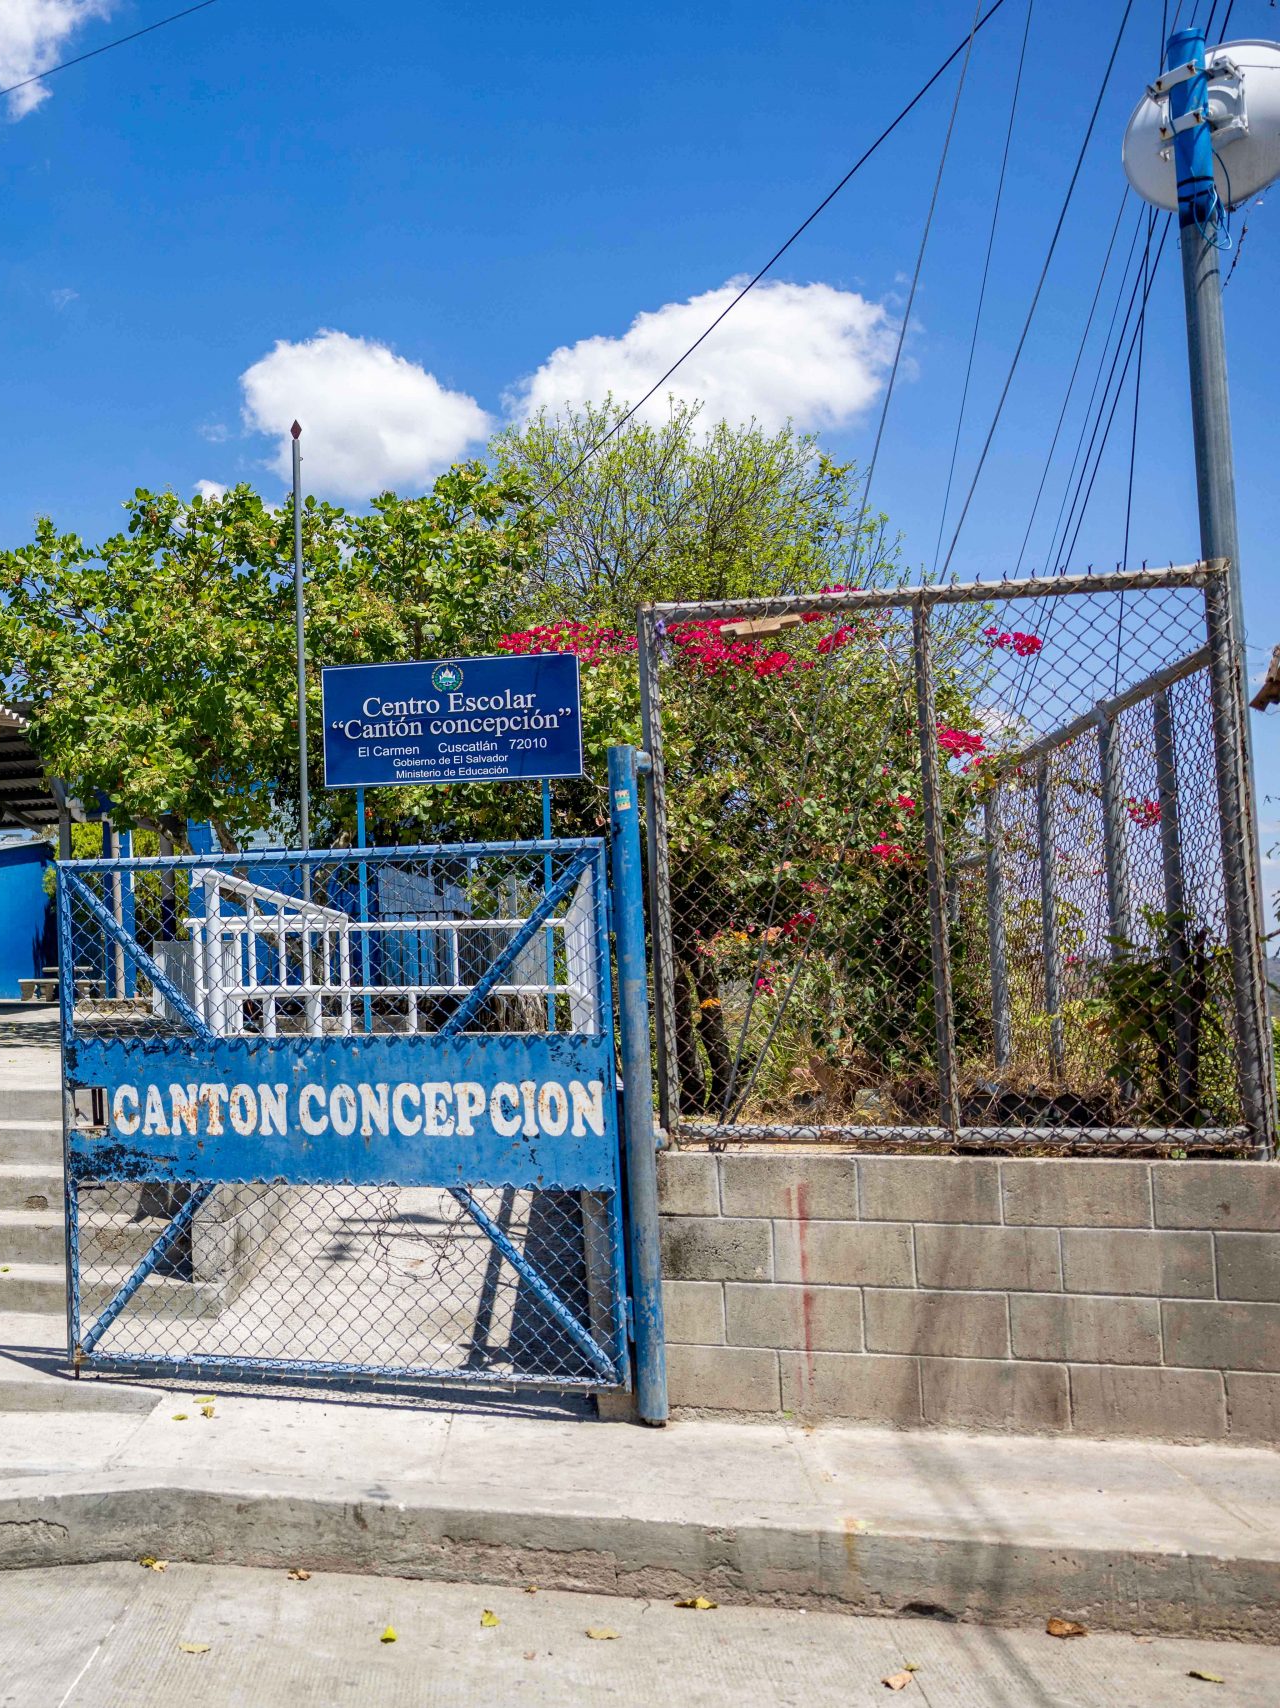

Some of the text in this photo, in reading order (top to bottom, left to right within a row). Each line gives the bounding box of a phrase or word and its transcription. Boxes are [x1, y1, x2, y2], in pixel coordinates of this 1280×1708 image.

[363, 689, 536, 717] Centro Escolar
[332, 708, 572, 739] “Cantón concepción”
[358, 737, 548, 757] El Carmen Cuscatlán 72010
[393, 753, 509, 767] Gobierno de El Salvador
[396, 765, 509, 779] Ministerio de Educación
[113, 1080, 606, 1137] CANTON CONCEPCION
